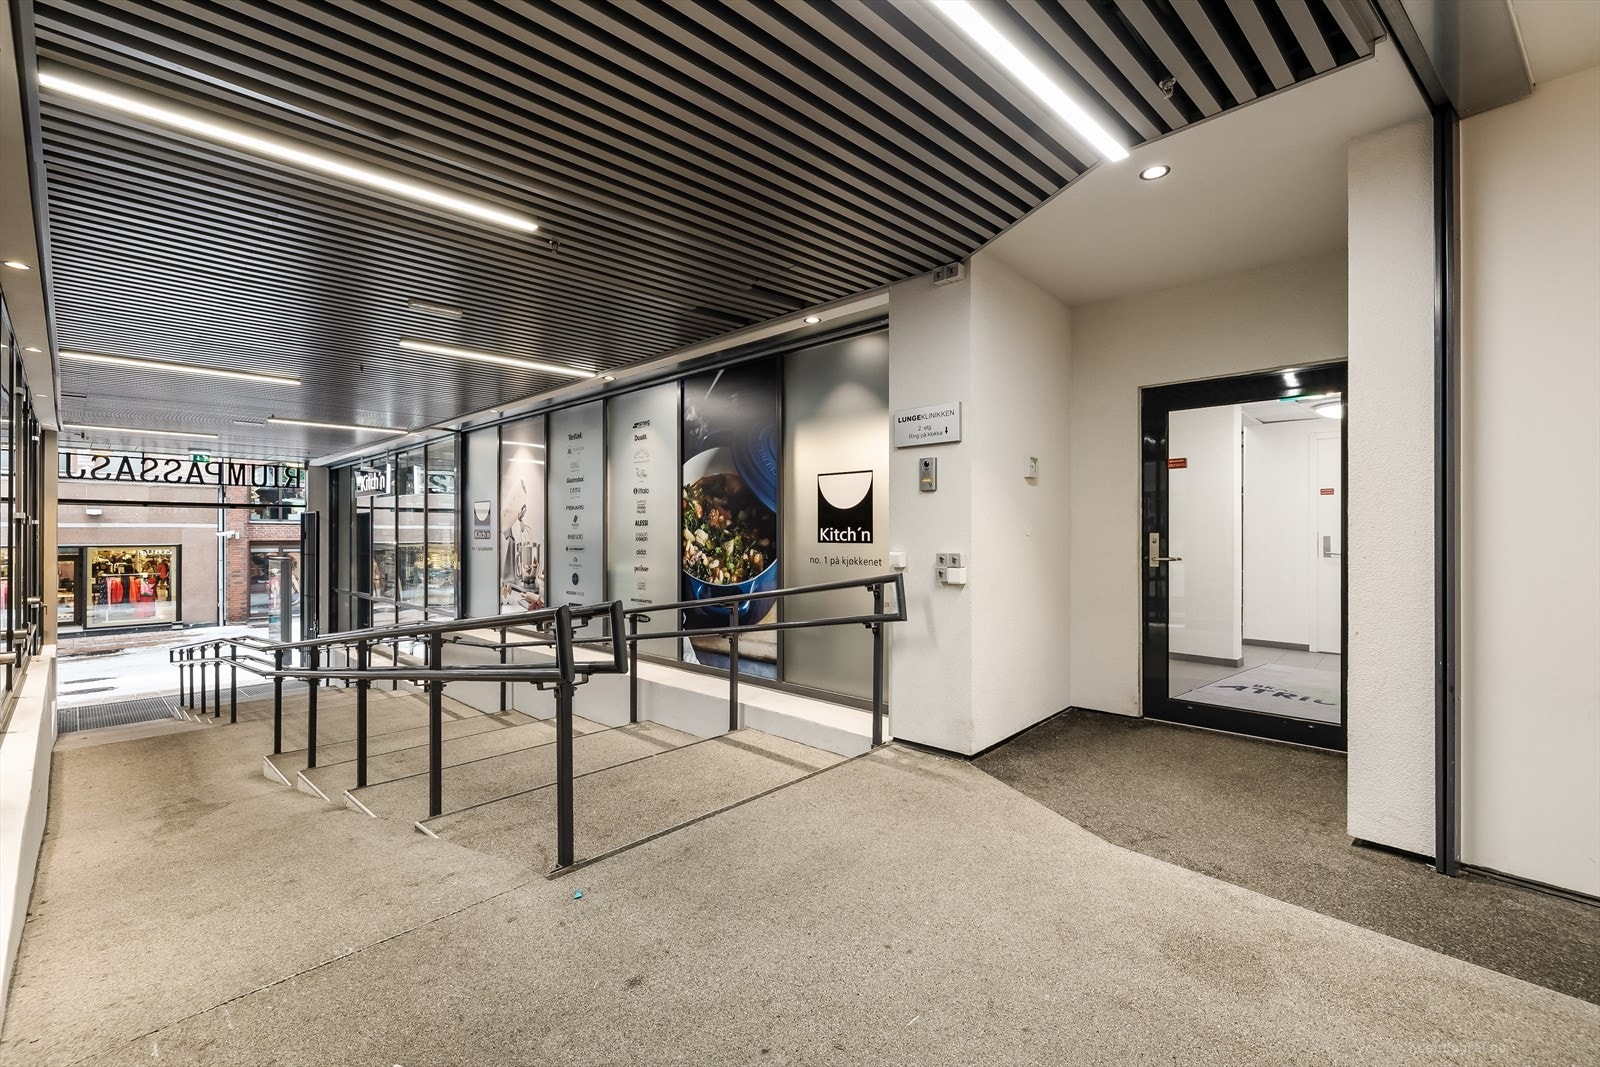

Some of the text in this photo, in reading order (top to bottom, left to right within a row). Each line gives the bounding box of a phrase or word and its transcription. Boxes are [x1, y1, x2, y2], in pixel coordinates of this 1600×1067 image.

[897, 409, 955, 423] LUNGEKLINIKKEN
[568, 432, 582, 440] Tefal
[810, 556, 821, 564] no.
[830, 556, 840, 565] på
[841, 557, 882, 567] kjøkkenet
